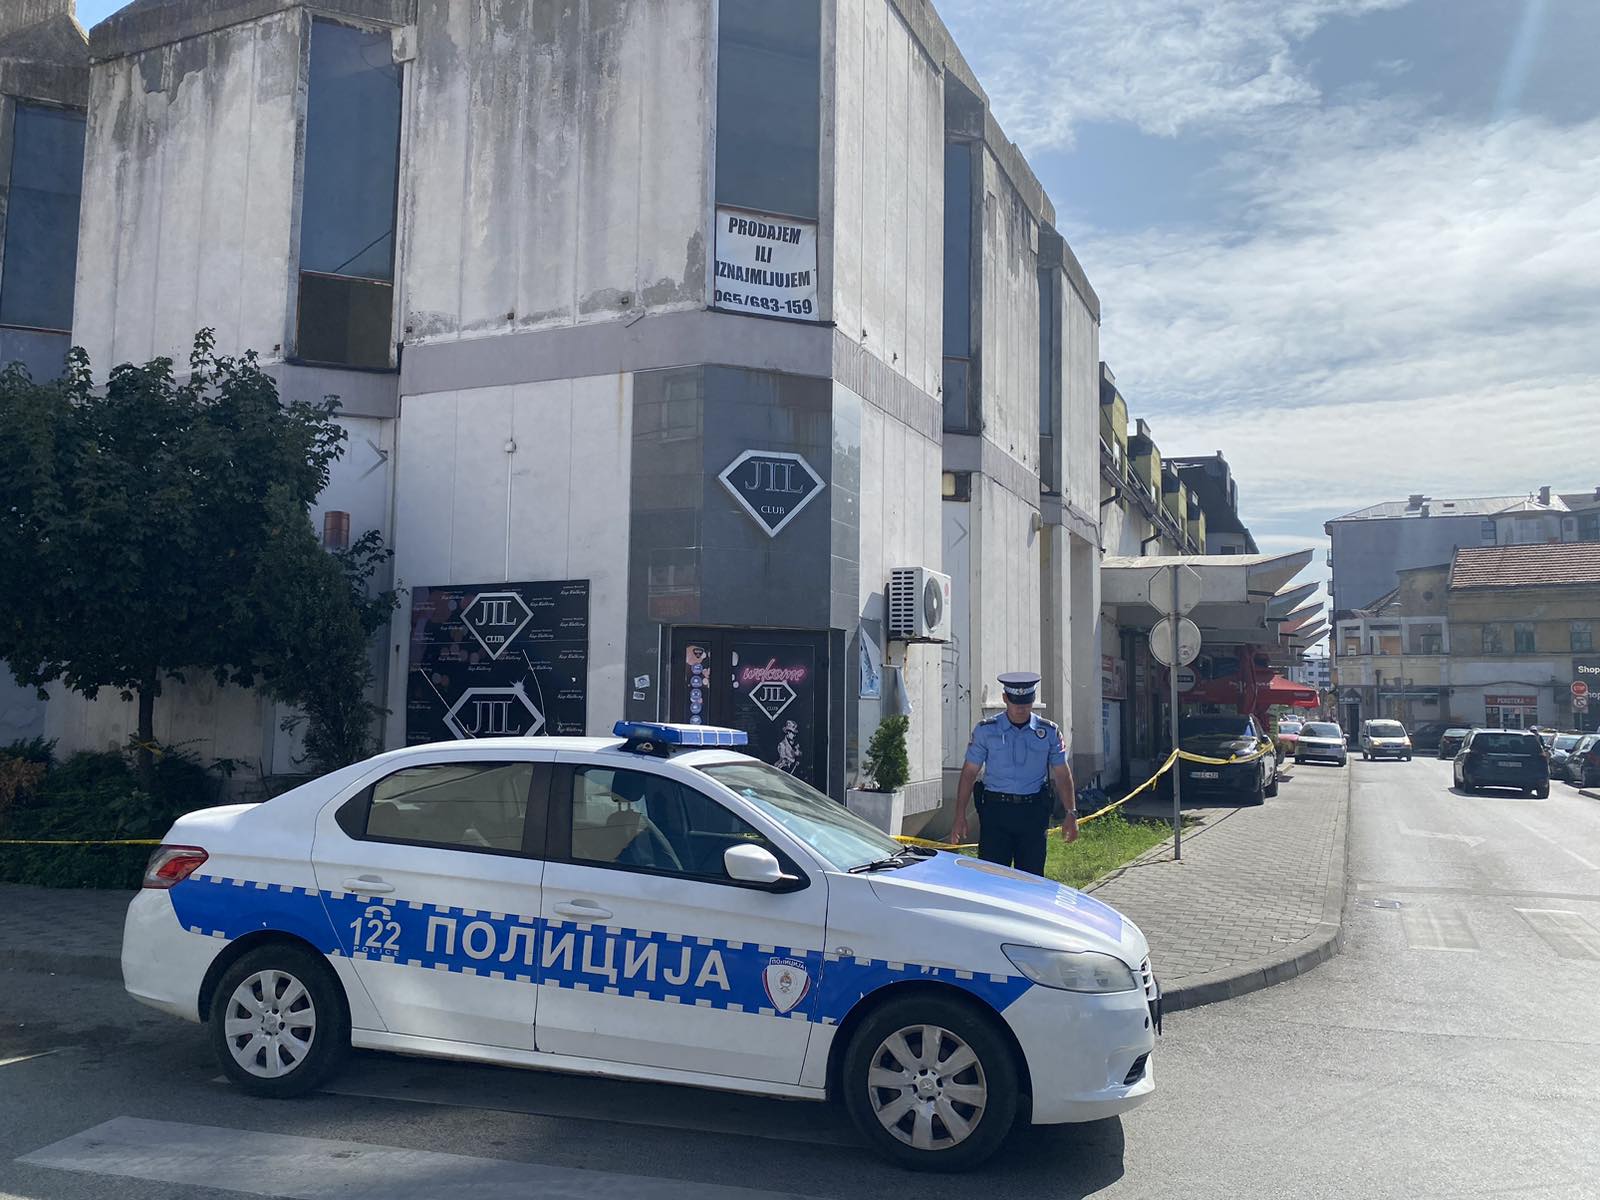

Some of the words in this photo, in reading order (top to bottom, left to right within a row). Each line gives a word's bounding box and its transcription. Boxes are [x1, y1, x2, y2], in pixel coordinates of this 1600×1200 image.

[728, 217, 801, 245] PRODAJEM
[755, 245, 772, 263] ILI
[714, 260, 810, 288] IZNAJMLJUJEM
[715, 289, 812, 315] 065/683-159
[745, 461, 803, 493] JIL
[760, 505, 785, 515] CLUB
[475, 600, 517, 626] JIL
[485, 635, 505, 644] CLUB
[743, 659, 804, 681] welcome
[759, 686, 786, 702] JIL
[466, 700, 521, 734] JIL
[350, 917, 401, 951] 122
[353, 945, 400, 957] POLICE
[425, 915, 731, 991] ПОЛИЦИЈА
